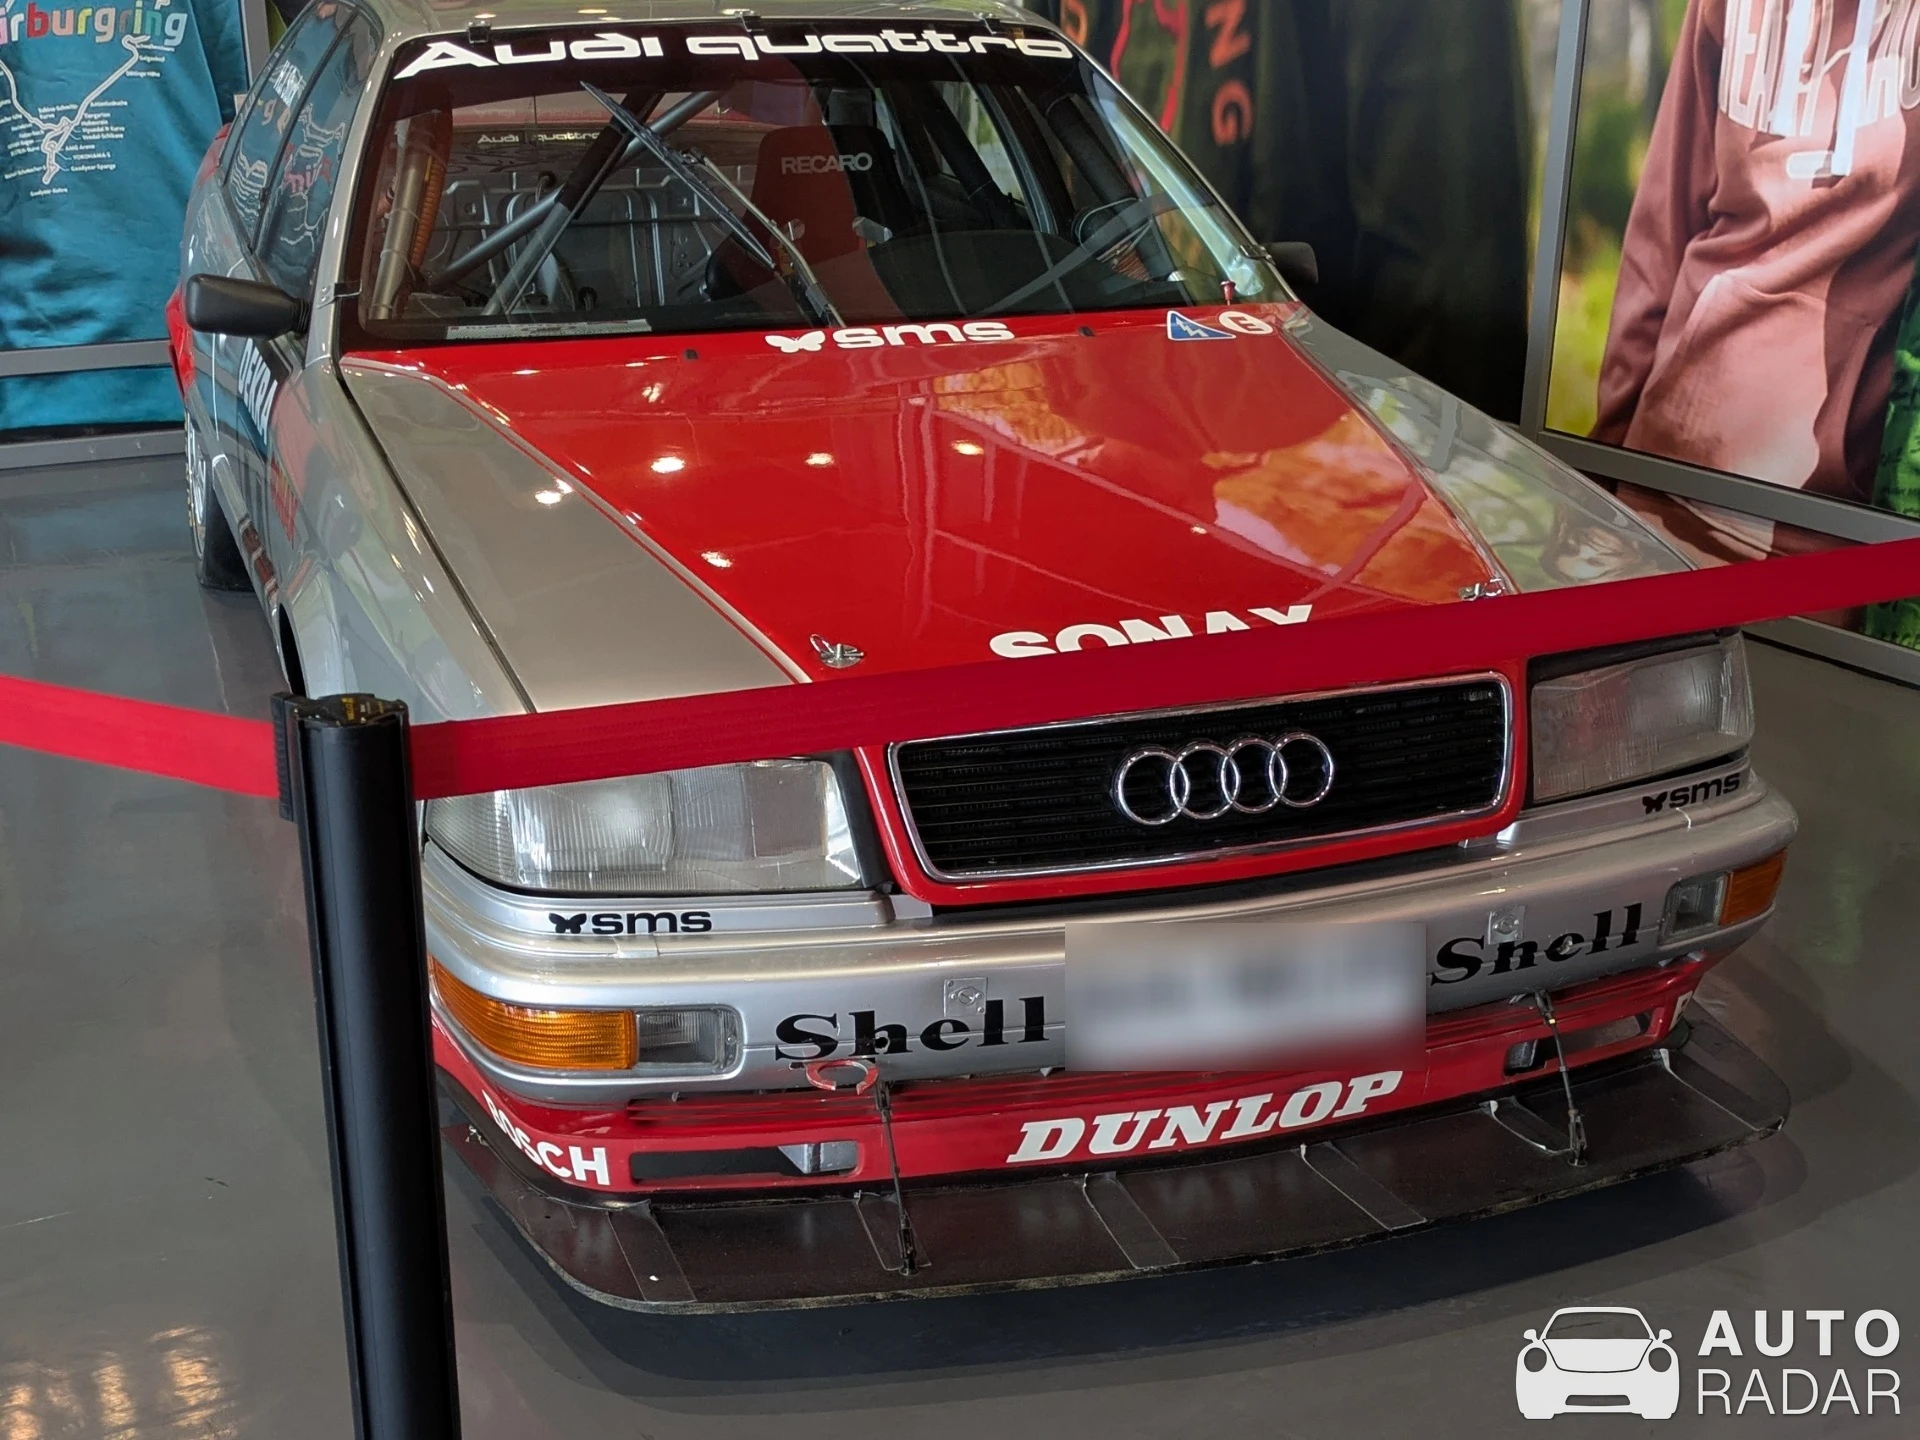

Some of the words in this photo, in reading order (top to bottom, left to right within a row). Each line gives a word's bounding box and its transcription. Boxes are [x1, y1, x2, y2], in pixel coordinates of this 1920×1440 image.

[393, 33, 664, 80] Audi
[686, 29, 1073, 61] quattro
[477, 134, 519, 144] Audi
[781, 152, 873, 175] RECARO
[833, 322, 1015, 349] sms
[238, 338, 278, 445] DEKRA
[1669, 773, 1740, 808] sms
[592, 910, 712, 935] sms
[1430, 903, 1642, 986] Shell
[775, 996, 1050, 1061] Shell
[482, 1089, 611, 1186] BOSCH
[1006, 1071, 1403, 1163] DUNLOP
